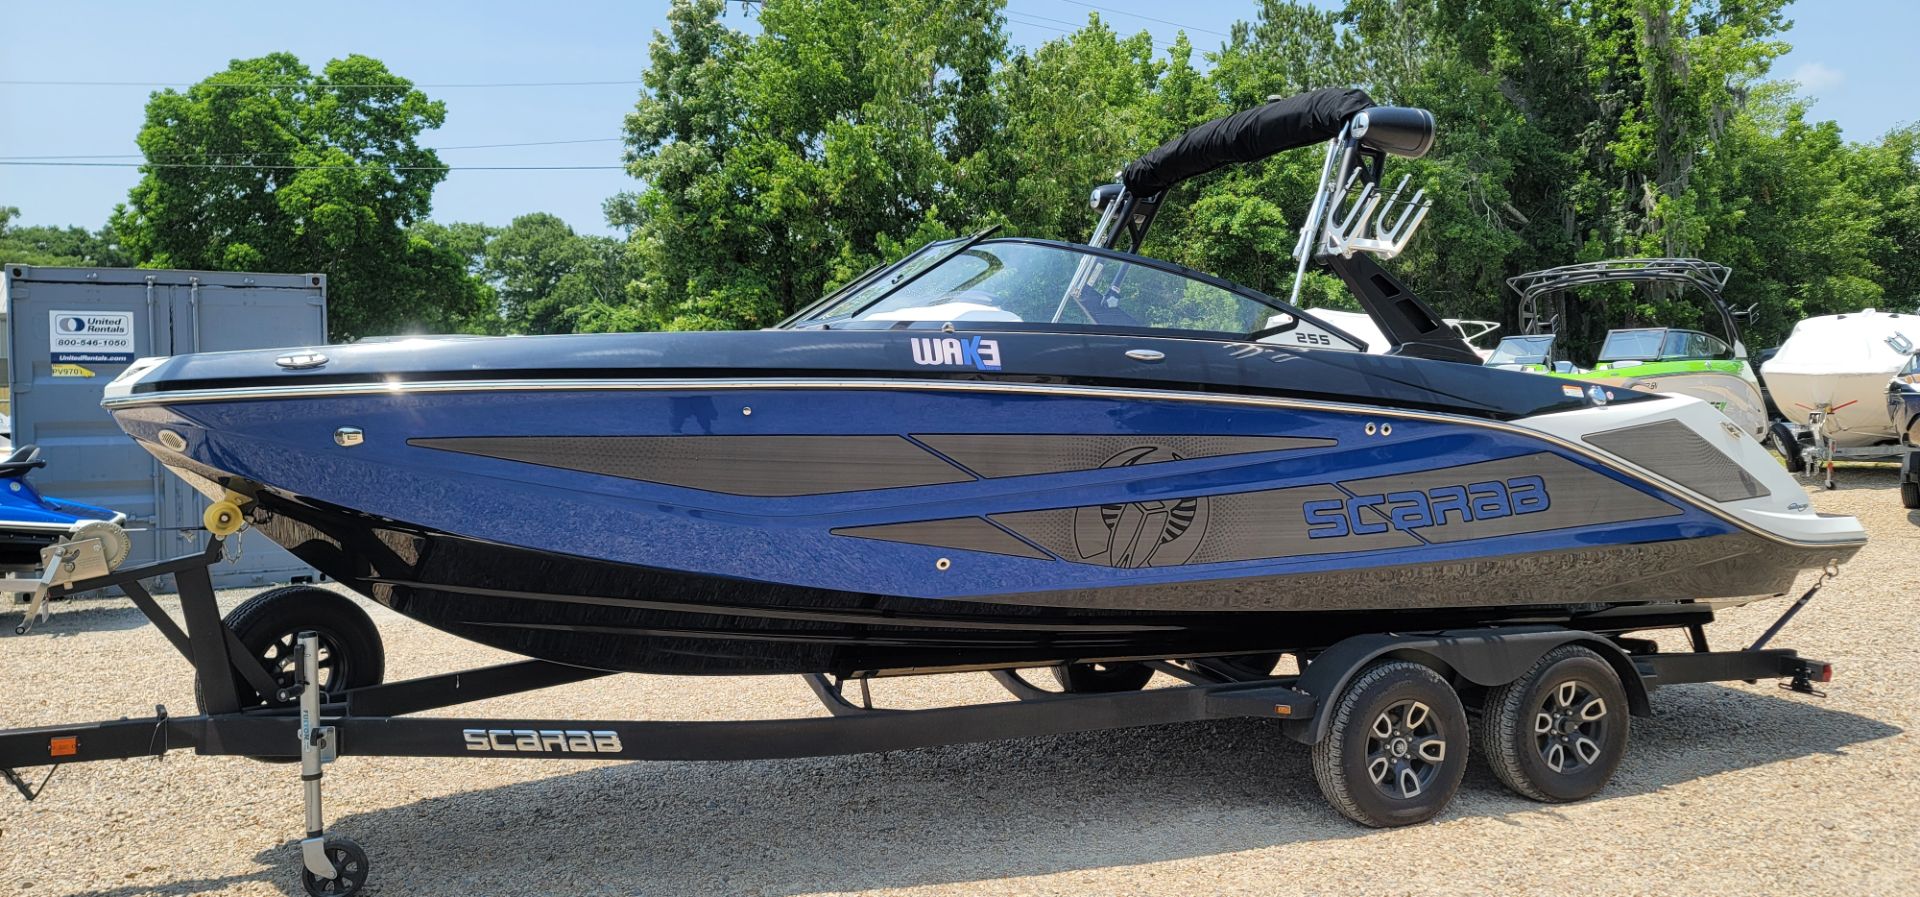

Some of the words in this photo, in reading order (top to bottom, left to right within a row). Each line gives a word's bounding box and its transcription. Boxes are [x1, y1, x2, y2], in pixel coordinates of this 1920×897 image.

[1296, 332, 1331, 346] 255
[1303, 475, 1551, 539] SCARAB
[463, 729, 623, 753] SCARAB
